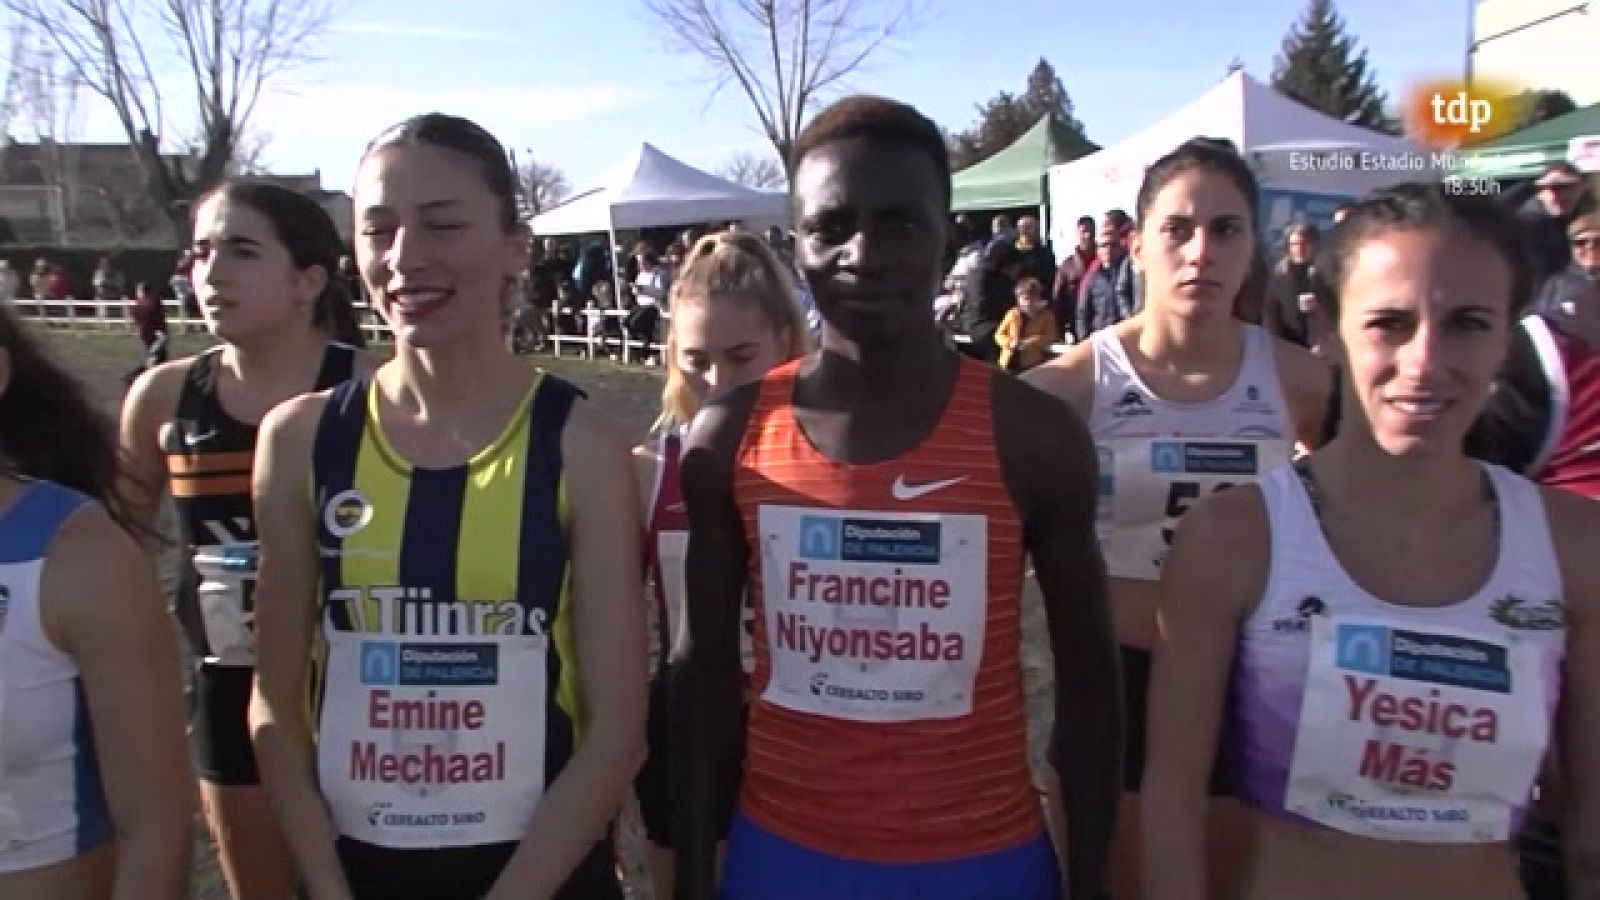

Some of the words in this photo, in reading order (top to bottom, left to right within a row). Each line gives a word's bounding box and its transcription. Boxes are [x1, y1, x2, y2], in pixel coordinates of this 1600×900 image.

[788, 562, 951, 608] Francine
[776, 611, 964, 664] Niyonsaba
[369, 690, 486, 731] Emine
[1344, 675, 1498, 744] Yesica
[350, 741, 506, 784] Mechaal
[1359, 739, 1456, 792] Más
